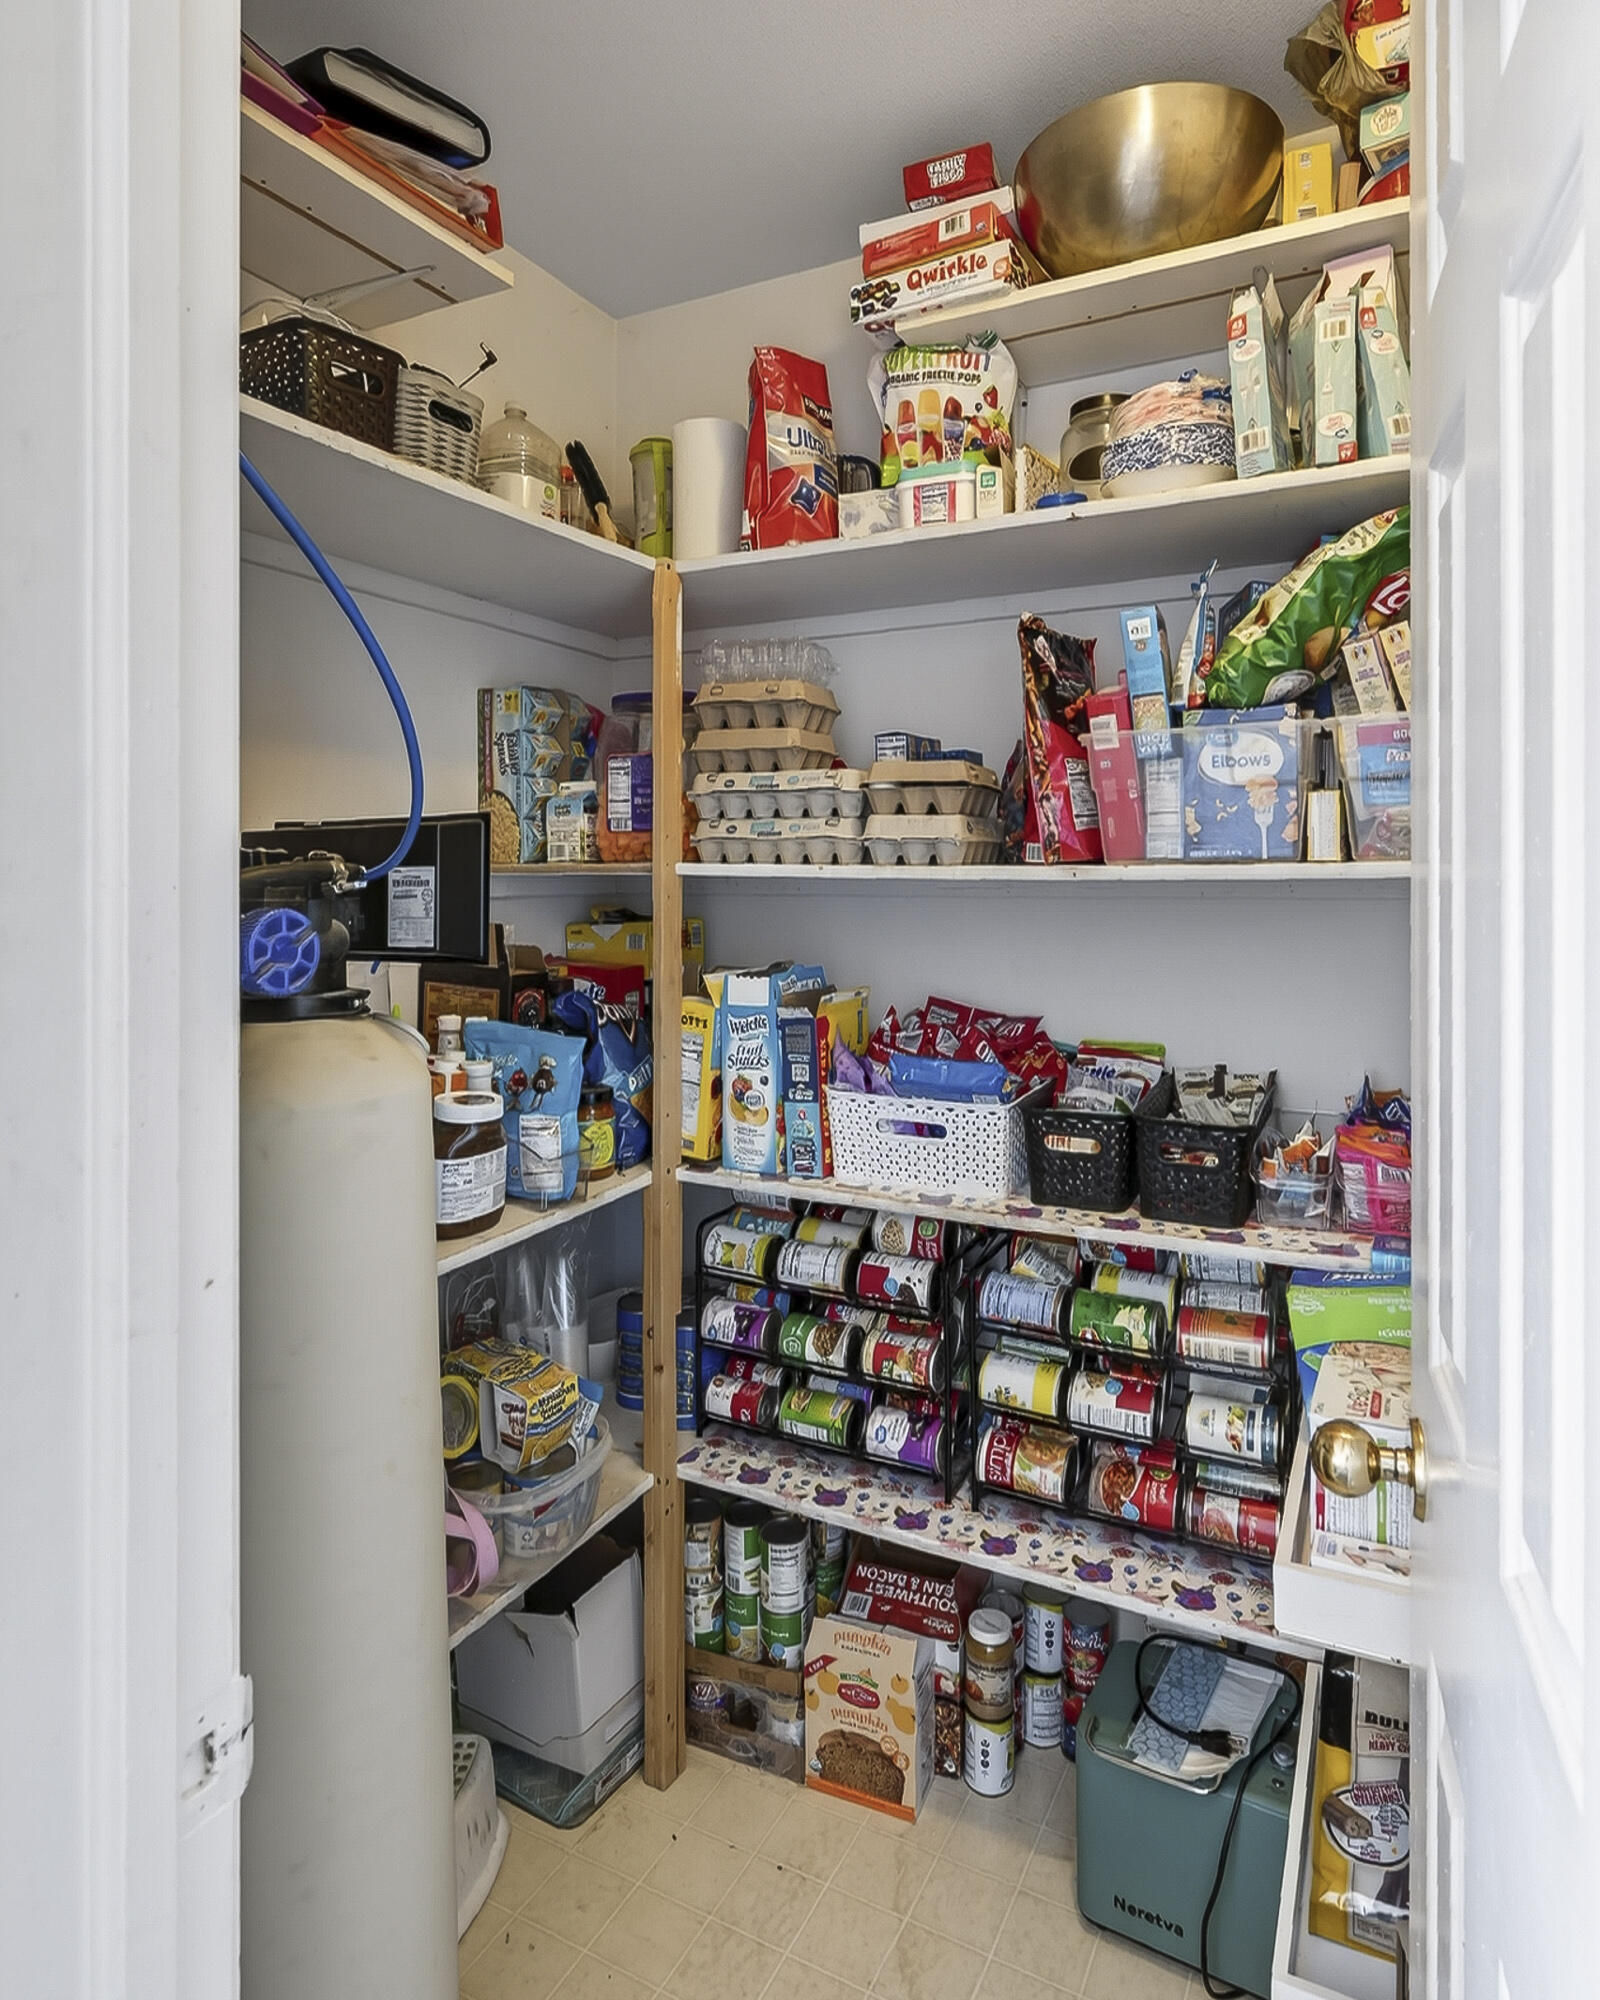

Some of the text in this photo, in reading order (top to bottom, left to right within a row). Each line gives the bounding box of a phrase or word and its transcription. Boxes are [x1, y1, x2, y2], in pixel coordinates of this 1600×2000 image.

[907, 253, 988, 291] Qwirkle
[1211, 754, 1272, 769] Elbows
[834, 1630, 892, 1656] pumpkin
[1113, 1893, 1184, 1938] Neretva
